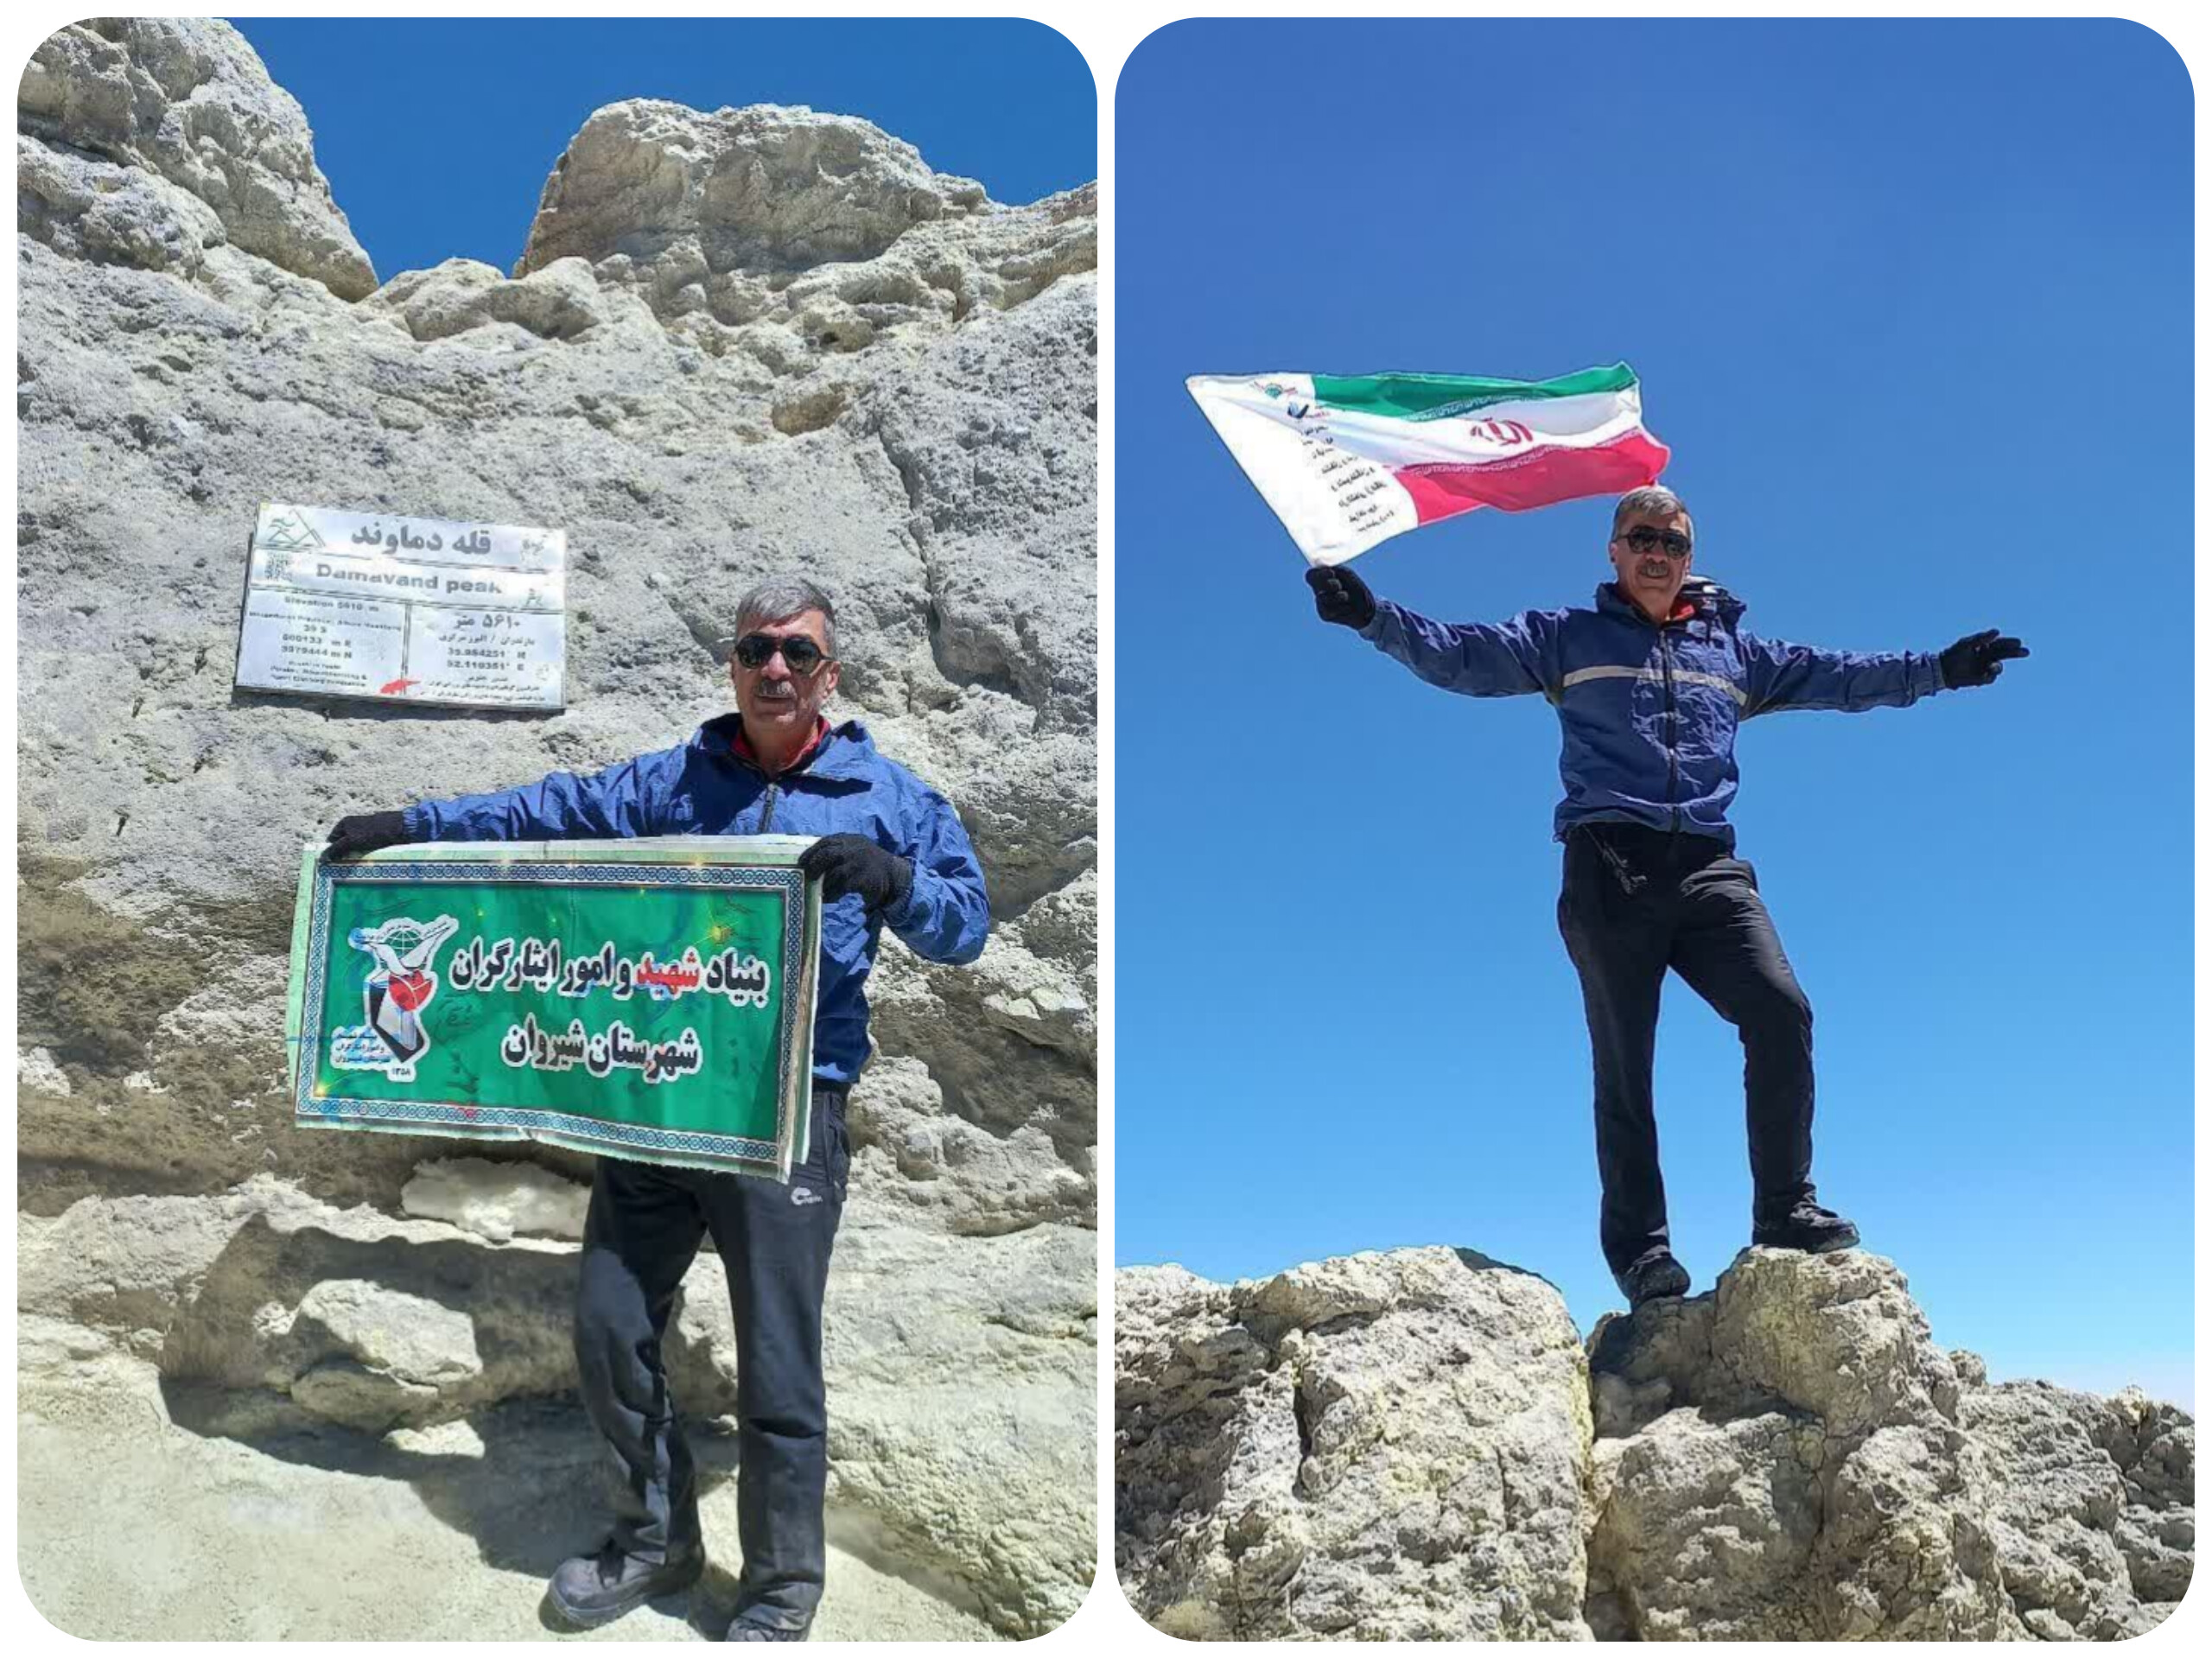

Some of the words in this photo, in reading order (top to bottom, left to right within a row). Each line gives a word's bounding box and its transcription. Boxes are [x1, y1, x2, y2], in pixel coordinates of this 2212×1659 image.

[351, 521, 443, 555] دماوند
[452, 530, 492, 555] قله
[316, 563, 439, 590] Damavand
[446, 579, 503, 594] peak
[482, 613, 521, 629] ۵۶۱۰
[451, 939, 559, 988] ایثارگران
[561, 947, 612, 993] امور
[616, 959, 632, 995] و
[636, 950, 700, 995] شهید
[705, 952, 766, 1002] بنیاد
[504, 1016, 586, 1066] شیروان
[588, 1023, 698, 1079] شهرستان
